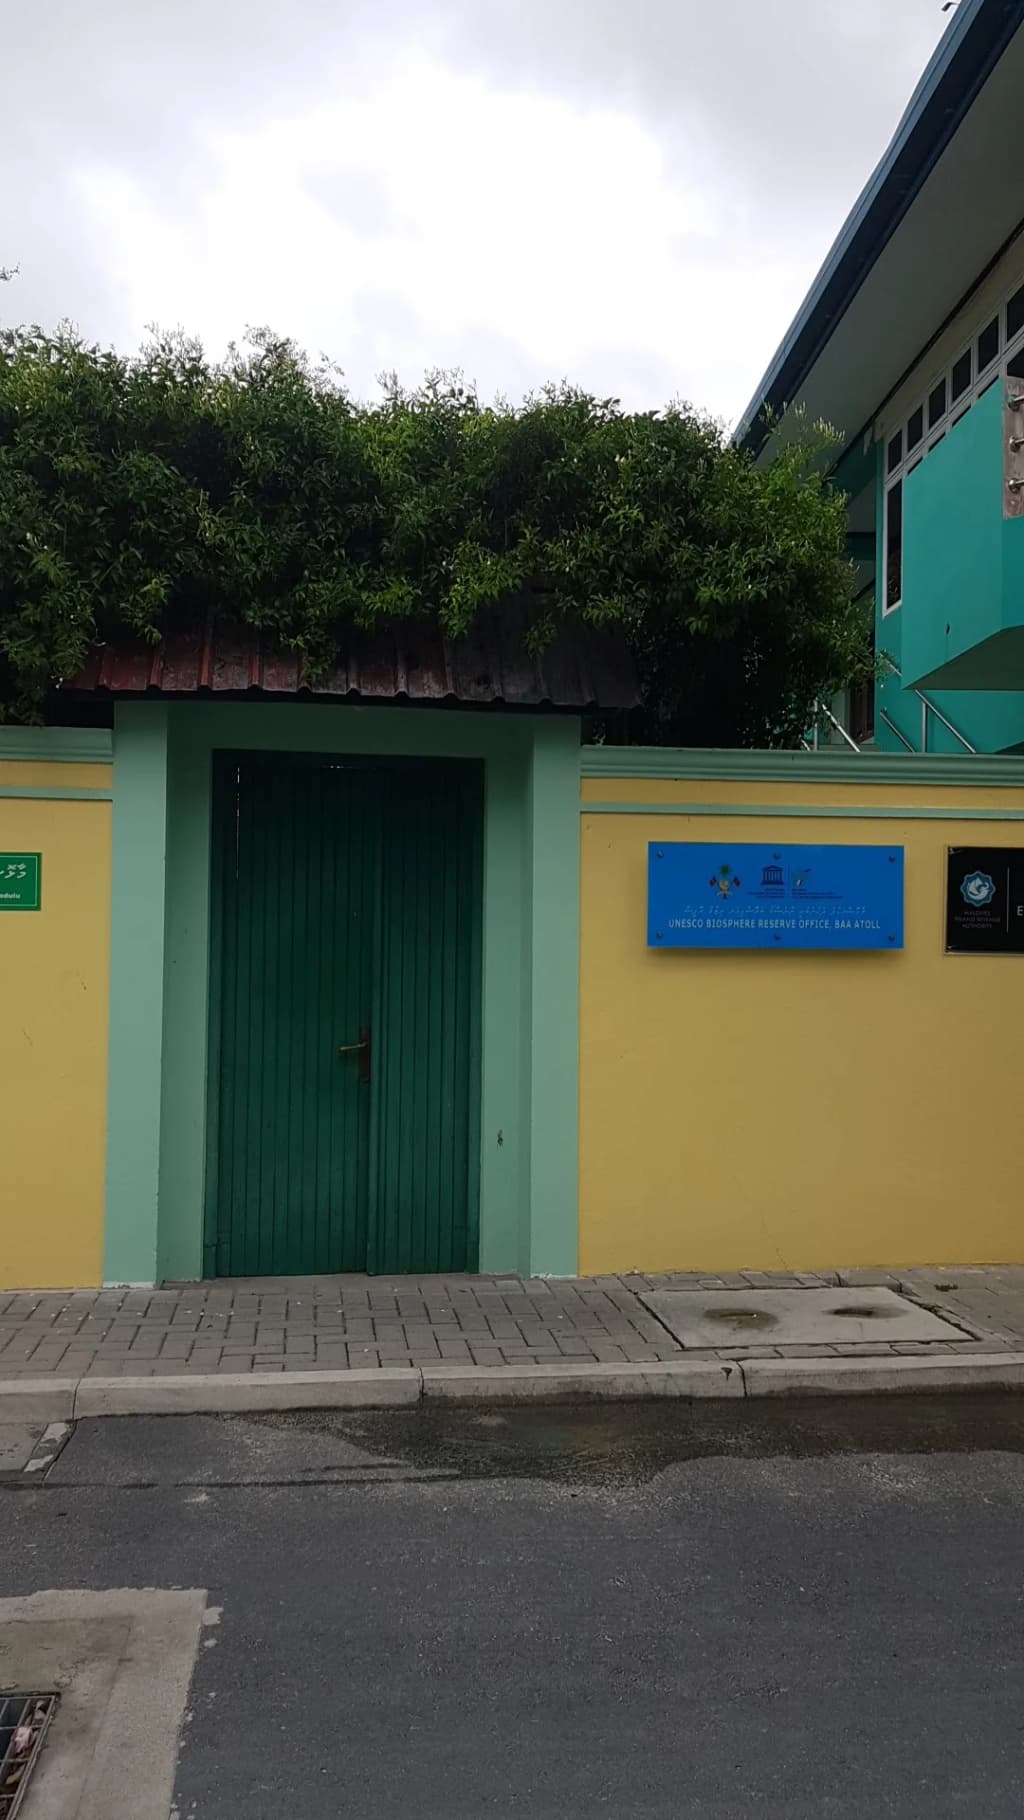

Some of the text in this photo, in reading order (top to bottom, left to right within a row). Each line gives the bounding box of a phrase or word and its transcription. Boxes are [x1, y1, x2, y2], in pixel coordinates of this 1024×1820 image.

[668, 919, 704, 928] UNESCO
[706, 919, 755, 928] BIOSPHERE
[758, 919, 796, 928] RESERVE
[834, 919, 852, 929] BAA
[854, 919, 881, 929] ATOLL
